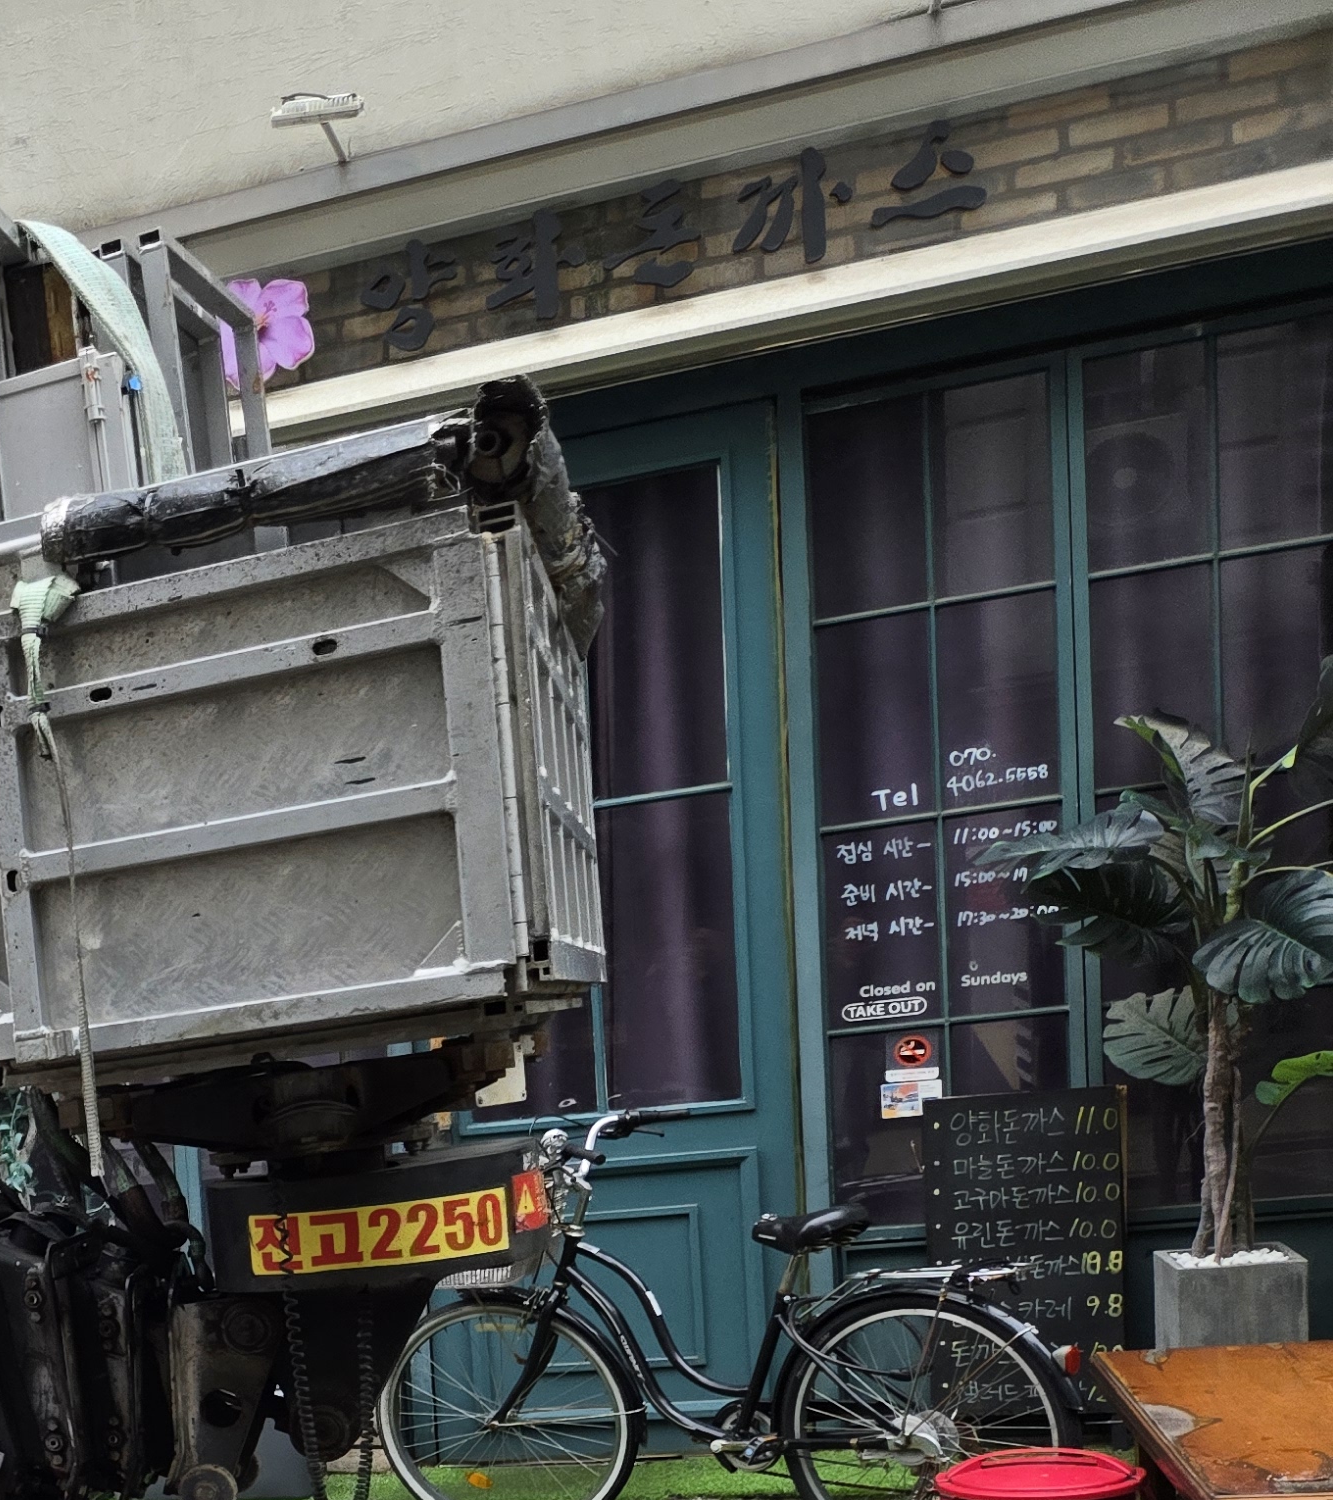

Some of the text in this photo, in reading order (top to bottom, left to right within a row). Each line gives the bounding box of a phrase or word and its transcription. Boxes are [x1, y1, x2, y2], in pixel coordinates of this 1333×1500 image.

[361, 122, 988, 353] 양화돈까스
[871, 783, 919, 811] Tel
[837, 841, 873, 865] 점심
[840, 883, 876, 907] 준비
[845, 921, 879, 941] 저녁
[859, 970, 1028, 998] Closed on Sundays
[847, 998, 921, 1019] TAKE OUT
[950, 1106, 1119, 1146] 양화돈까스 11.0
[953, 1150, 1120, 1180] 마늘돈까스 10.0
[953, 1182, 1121, 1210] 고구마돈까스 10.0
[254, 1193, 503, 1272] 전고2250
[1069, 1218, 1118, 1238] 10.0
[1086, 1293, 1123, 1318] 9.8
